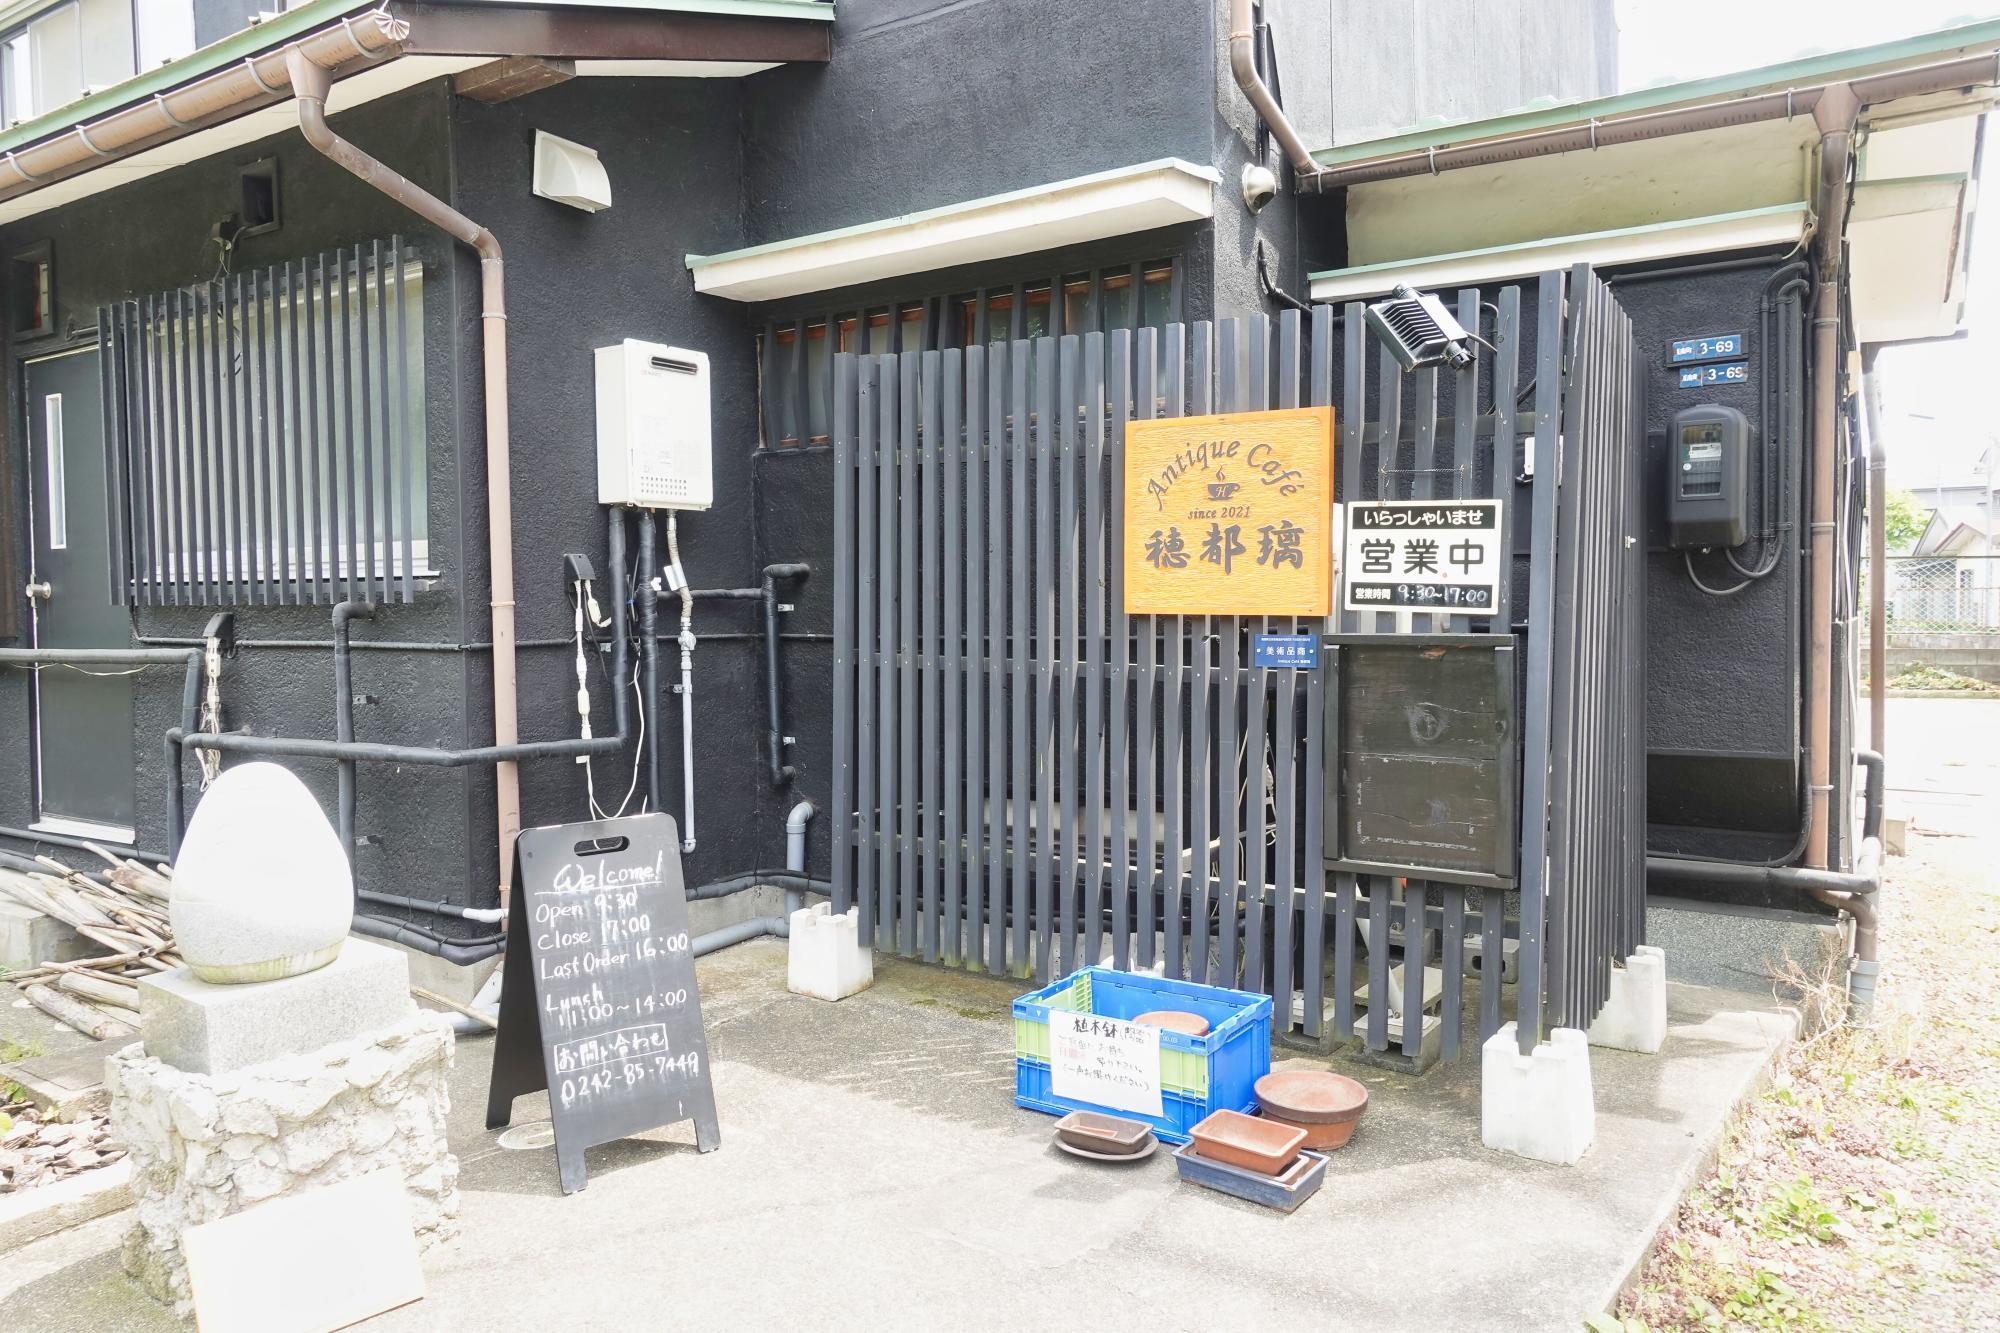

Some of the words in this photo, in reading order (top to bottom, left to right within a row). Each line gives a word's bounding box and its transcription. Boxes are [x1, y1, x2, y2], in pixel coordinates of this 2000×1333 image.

[1700, 340, 1734, 355] 3-69
[1707, 366, 1744, 380] 3-69
[1147, 440, 1241, 512] Antique
[1246, 442, 1305, 497] Café
[1187, 507, 1217, 520] since
[1220, 505, 1251, 519] 2021
[1363, 509, 1484, 526] いらっしゃいませ
[1144, 520, 1305, 576] 穂都璃
[1360, 538, 1484, 575] 営業中
[1355, 588, 1392, 600] 営業時間
[552, 850, 663, 892] Welcome!
[535, 902, 584, 927] Open
[594, 888, 638, 911] 9:30
[537, 930, 591, 951] Close
[600, 914, 650, 945] 17:00
[541, 956, 579, 980] Last
[583, 952, 630, 973] Order
[636, 933, 688, 960] 16:00
[545, 982, 604, 1013] Lunch
[561, 1051, 699, 1105] 0242-85-7449
